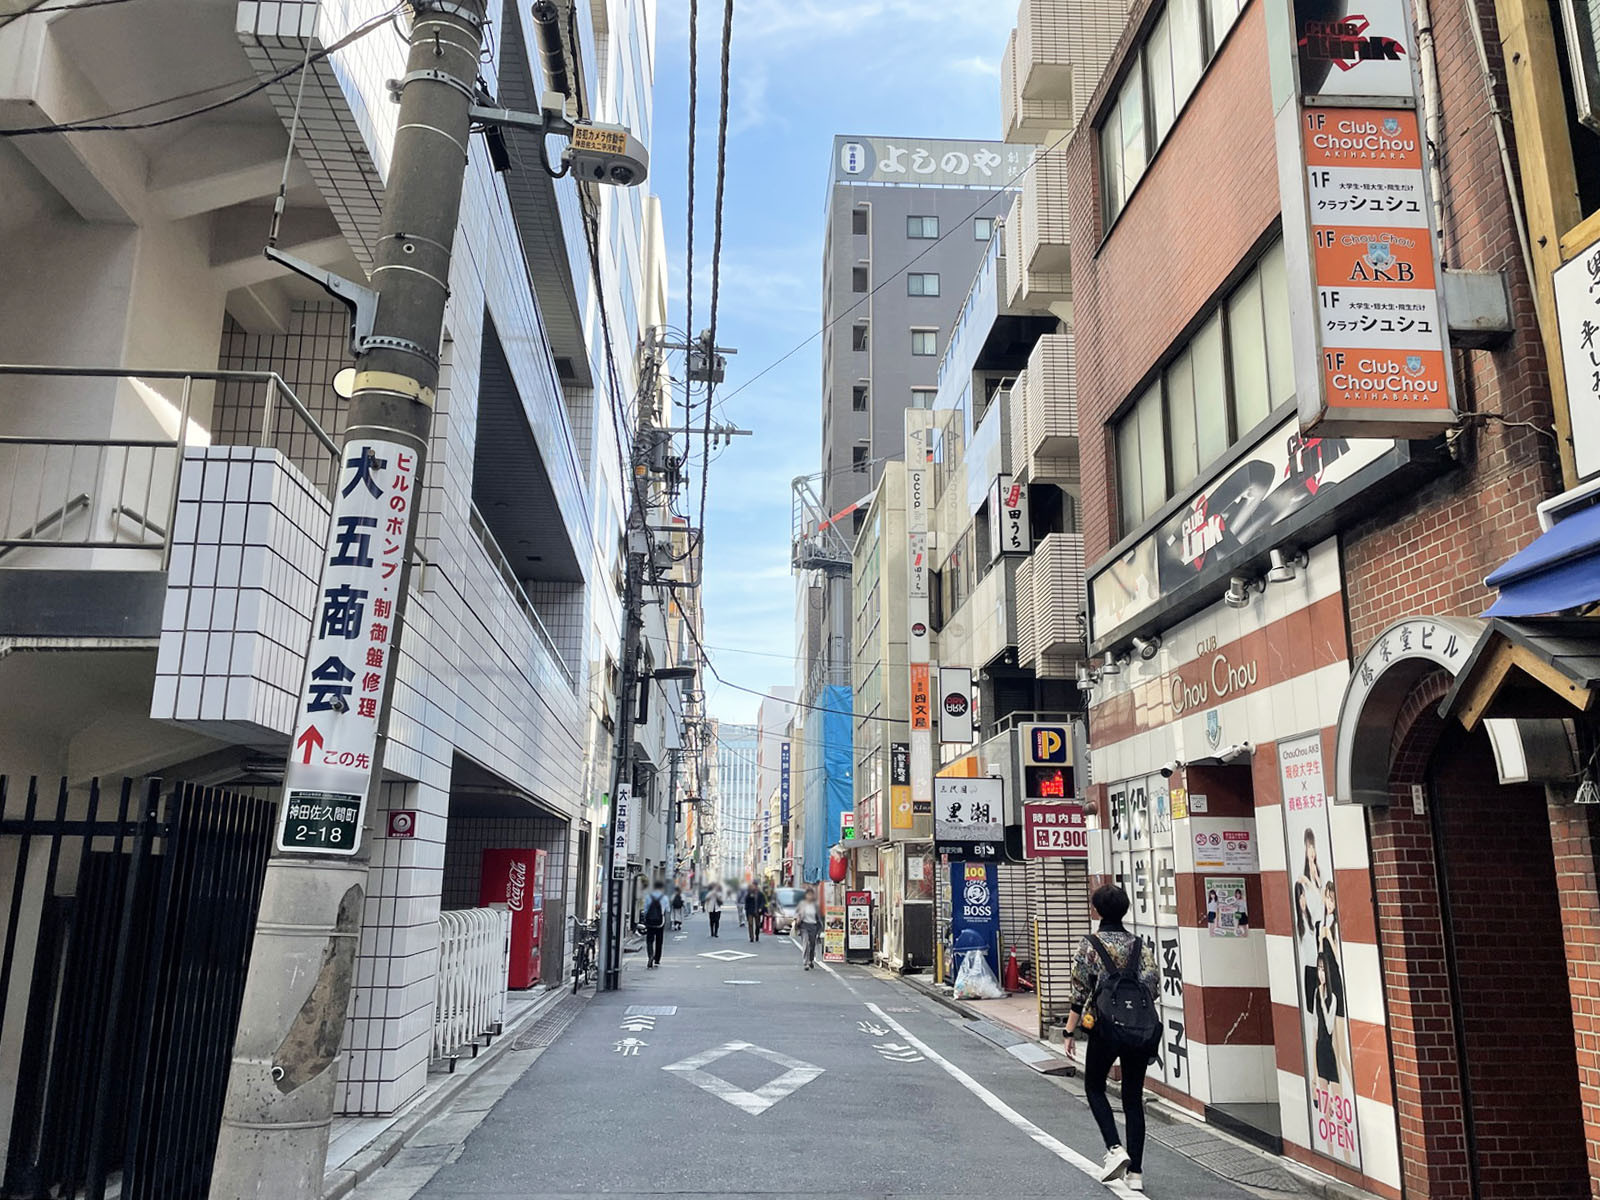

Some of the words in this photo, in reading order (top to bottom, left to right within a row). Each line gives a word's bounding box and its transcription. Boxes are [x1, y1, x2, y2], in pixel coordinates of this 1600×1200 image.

[1307, 114, 1326, 130] 1F
[1338, 120, 1378, 134] Club
[1313, 134, 1414, 151] ChouChou
[1324, 151, 1406, 160] AKIHABARA
[1311, 171, 1330, 188] 1F
[1317, 195, 1421, 212] クラブシュシュ
[1316, 230, 1336, 248] 1F
[1341, 234, 1376, 246] Chou
[1379, 233, 1415, 248] Chou
[1349, 261, 1415, 282] AKB
[1320, 291, 1340, 308] 1F
[1326, 315, 1433, 333] クラブシュシュ
[1325, 353, 1345, 370] 1F
[1358, 359, 1400, 374] Club
[1332, 374, 1438, 392] ChouChou
[1344, 392, 1430, 401] AKIHABARA
[1181, 508, 1205, 536] CLUB
[306, 446, 387, 714] 大五商会
[357, 452, 414, 719] ビルのポンプ・制御盤修理
[1171, 674, 1208, 714] Chou
[1211, 654, 1258, 697] Chou
[322, 749, 370, 769] この先
[289, 804, 358, 823] 神田佐久間町
[945, 801, 990, 824] 黒潮
[295, 825, 342, 843] 2-18
[965, 867, 985, 877] 100
[507, 859, 526, 911] Coca-Cola
[964, 905, 991, 916] BOSS
[1316, 1088, 1352, 1124] 17:30
[1319, 1117, 1355, 1152] OPEN
